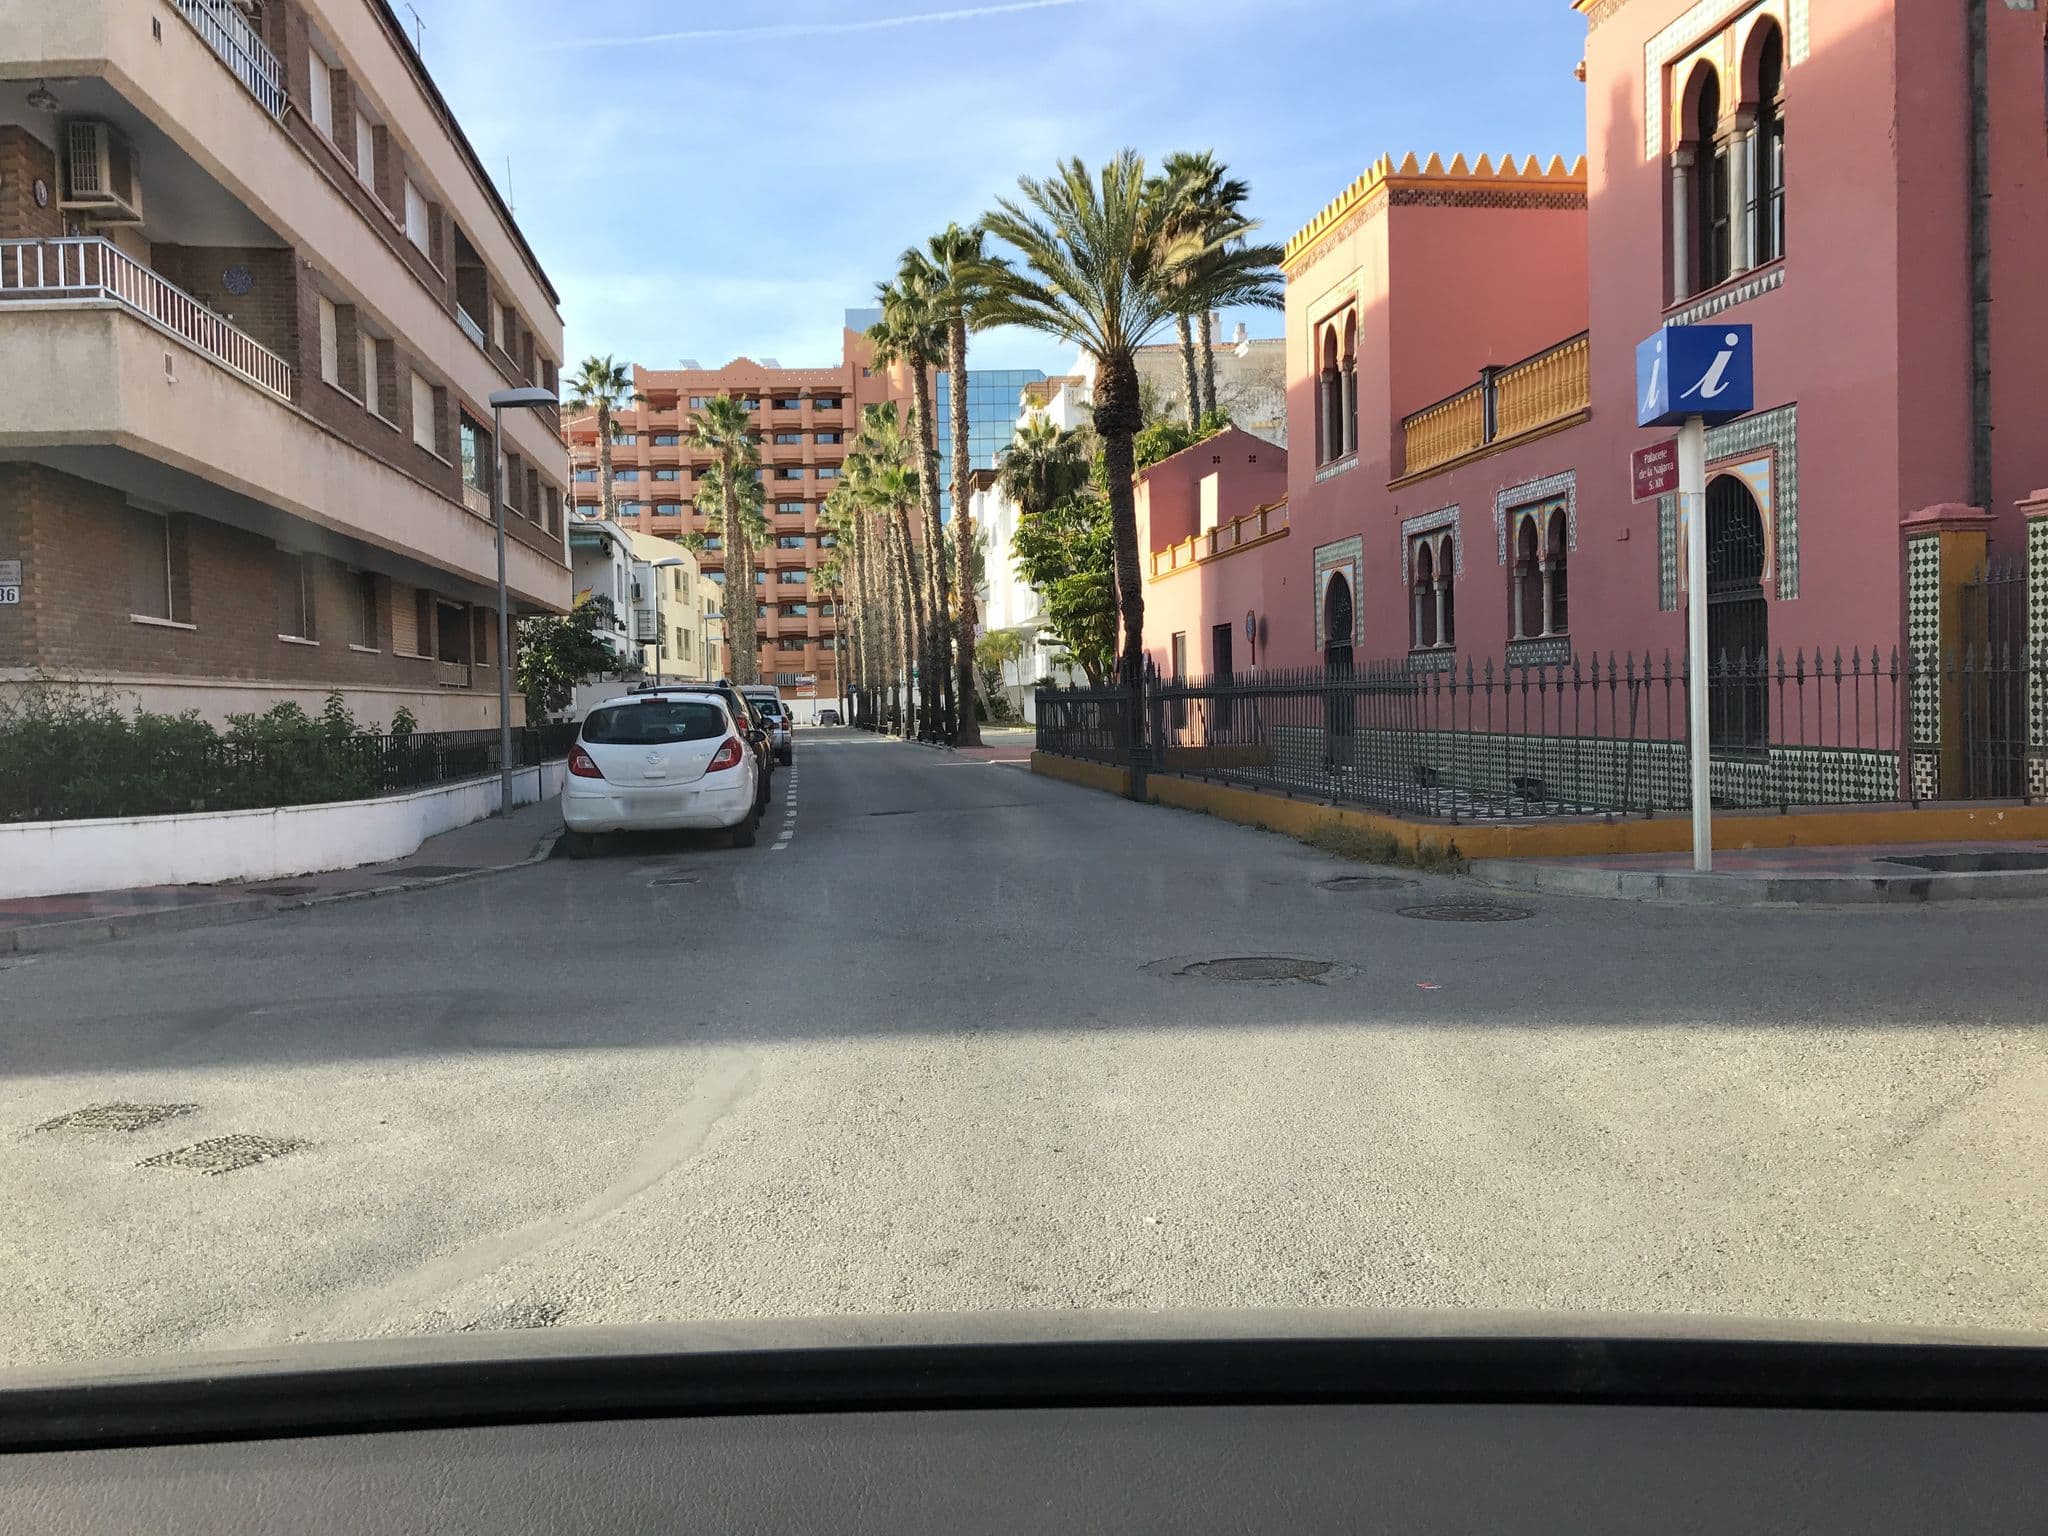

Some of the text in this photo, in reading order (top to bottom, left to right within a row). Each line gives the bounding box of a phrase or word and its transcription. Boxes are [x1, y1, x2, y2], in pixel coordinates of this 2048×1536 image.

[1680, 332, 1739, 399] i
[1641, 340, 1661, 413] i
[1644, 449, 1667, 464] Palacete
[1639, 469, 1646, 479] de
[1647, 466, 1652, 477] la
[1655, 477, 1664, 489] XIX
